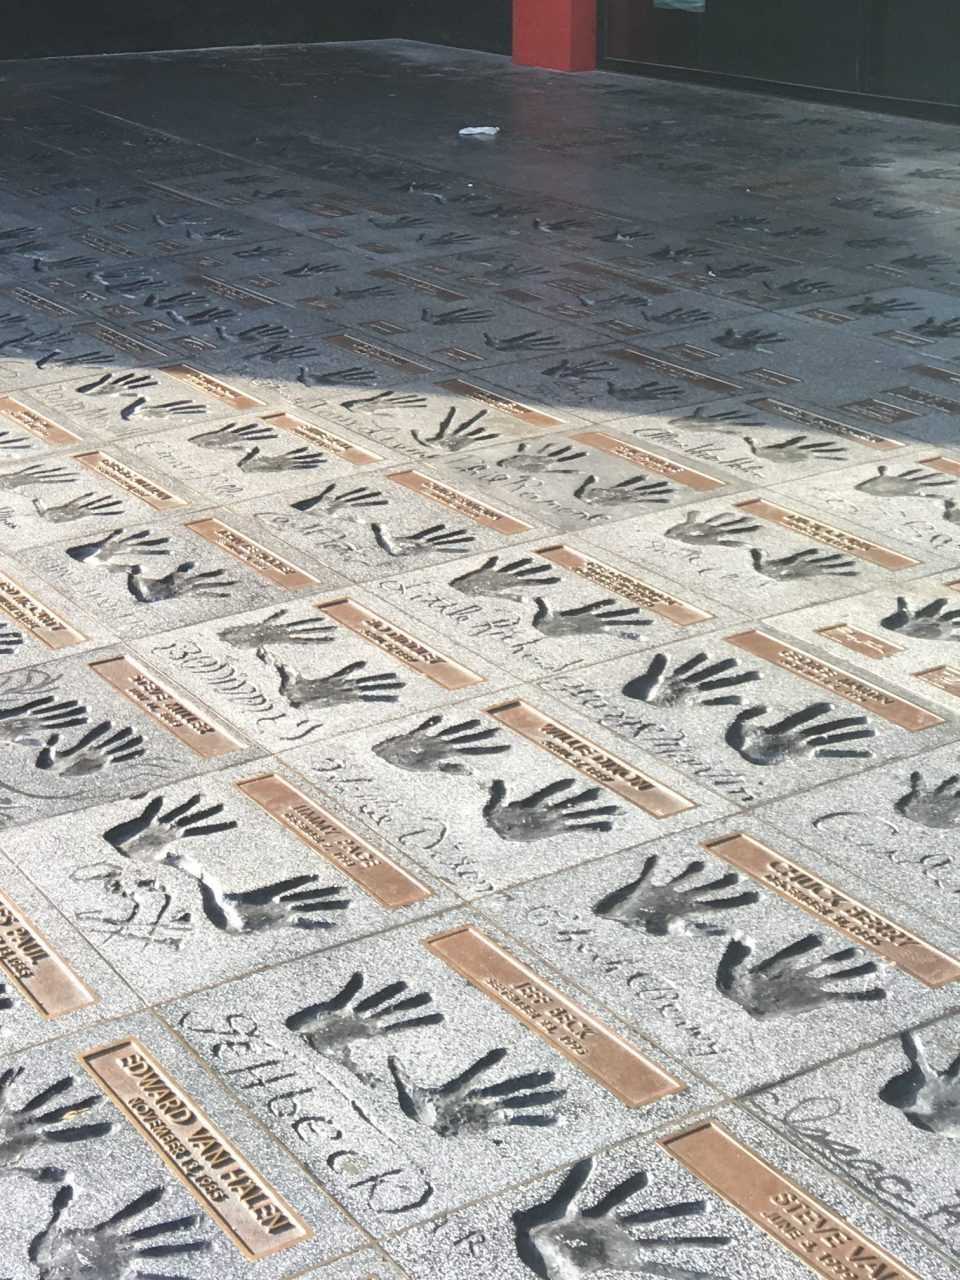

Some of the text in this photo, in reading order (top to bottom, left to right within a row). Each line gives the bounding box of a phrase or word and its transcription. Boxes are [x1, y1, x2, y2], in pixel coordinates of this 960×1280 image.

[127, 674, 218, 735] STEVE MILLER
[536, 723, 656, 791] WILLIE DIXON
[288, 803, 382, 868] JIMMY PAGE
[761, 859, 917, 947] CHUCK BERRY
[4, 927, 54, 966] PAUL
[511, 980, 598, 1041] JEFF BECK
[113, 1052, 200, 1130] EDWARD
[181, 1126, 238, 1173] VAN
[217, 1166, 298, 1238] HALEN
[125, 1095, 190, 1158] NOVEMBER
[756, 1209, 808, 1241] JUNE
[761, 1189, 856, 1249] STEVE
